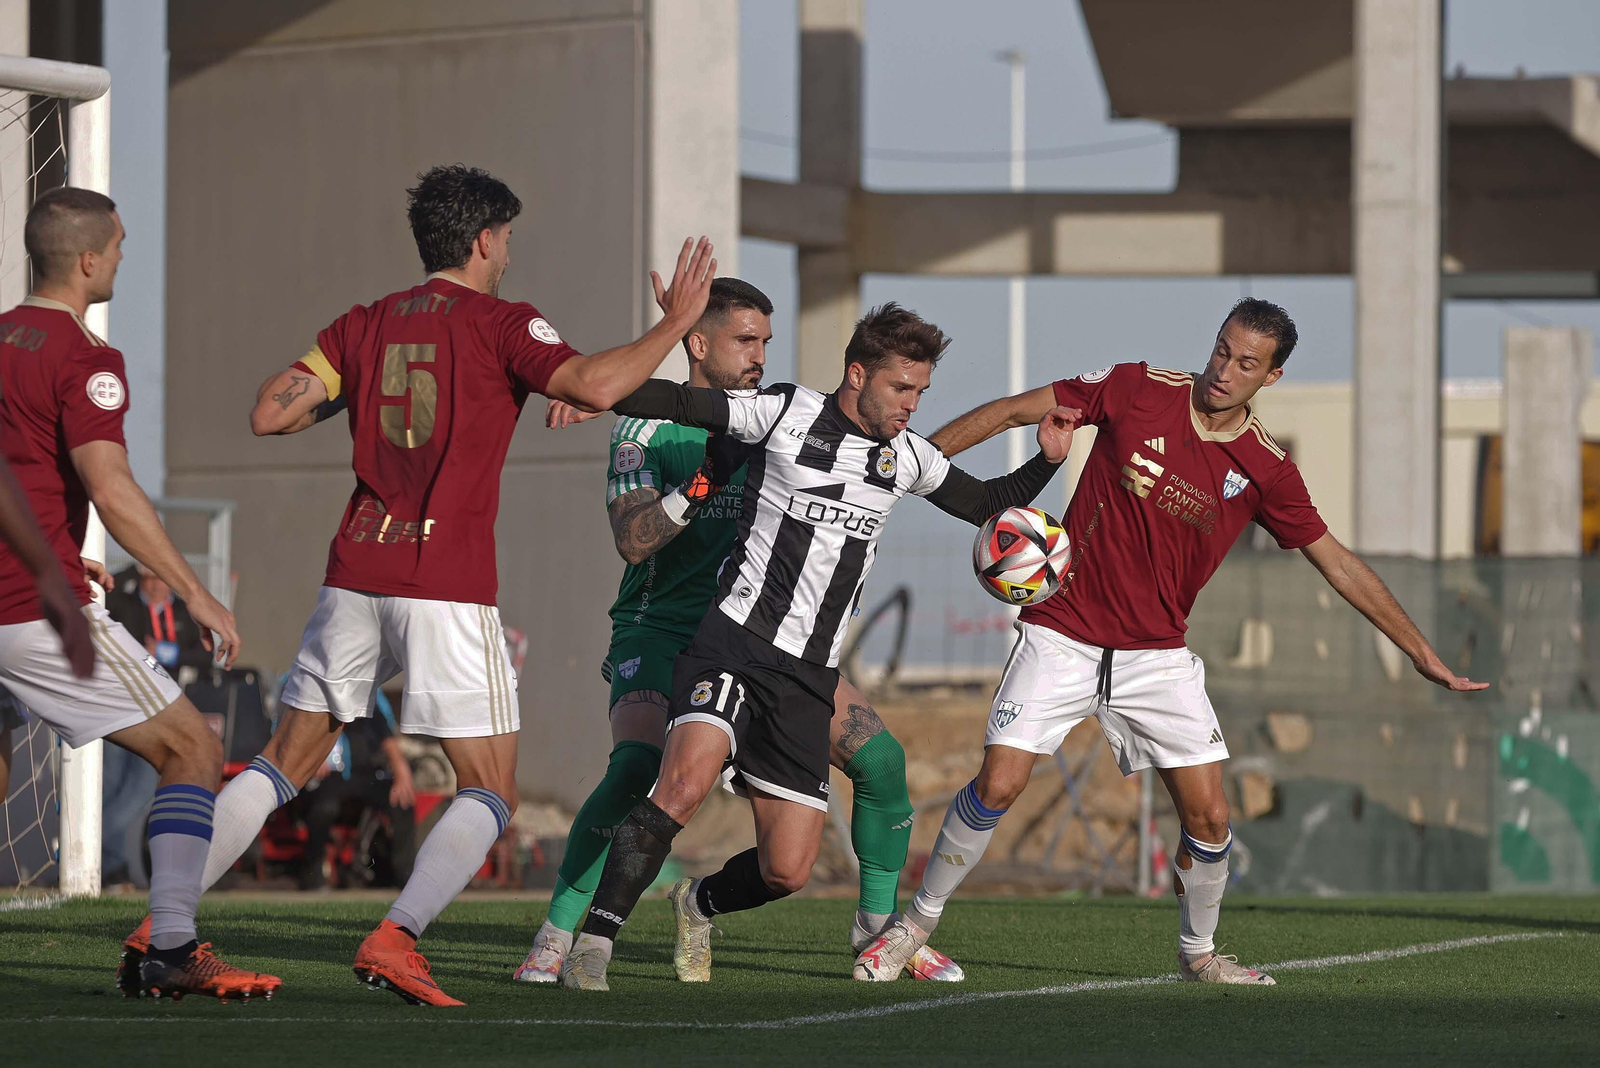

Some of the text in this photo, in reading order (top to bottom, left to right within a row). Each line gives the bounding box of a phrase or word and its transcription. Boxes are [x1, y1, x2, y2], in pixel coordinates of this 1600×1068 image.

[379, 343, 438, 448] 5
[789, 428, 831, 451] LEGEA
[1163, 485, 1205, 516] CANTE
[1169, 474, 1218, 507] FUNDACIÓN
[700, 506, 723, 519] LAS
[787, 495, 879, 536] LOTUS
[1155, 496, 1214, 535] LAS MINAS
[715, 672, 745, 723] 11
